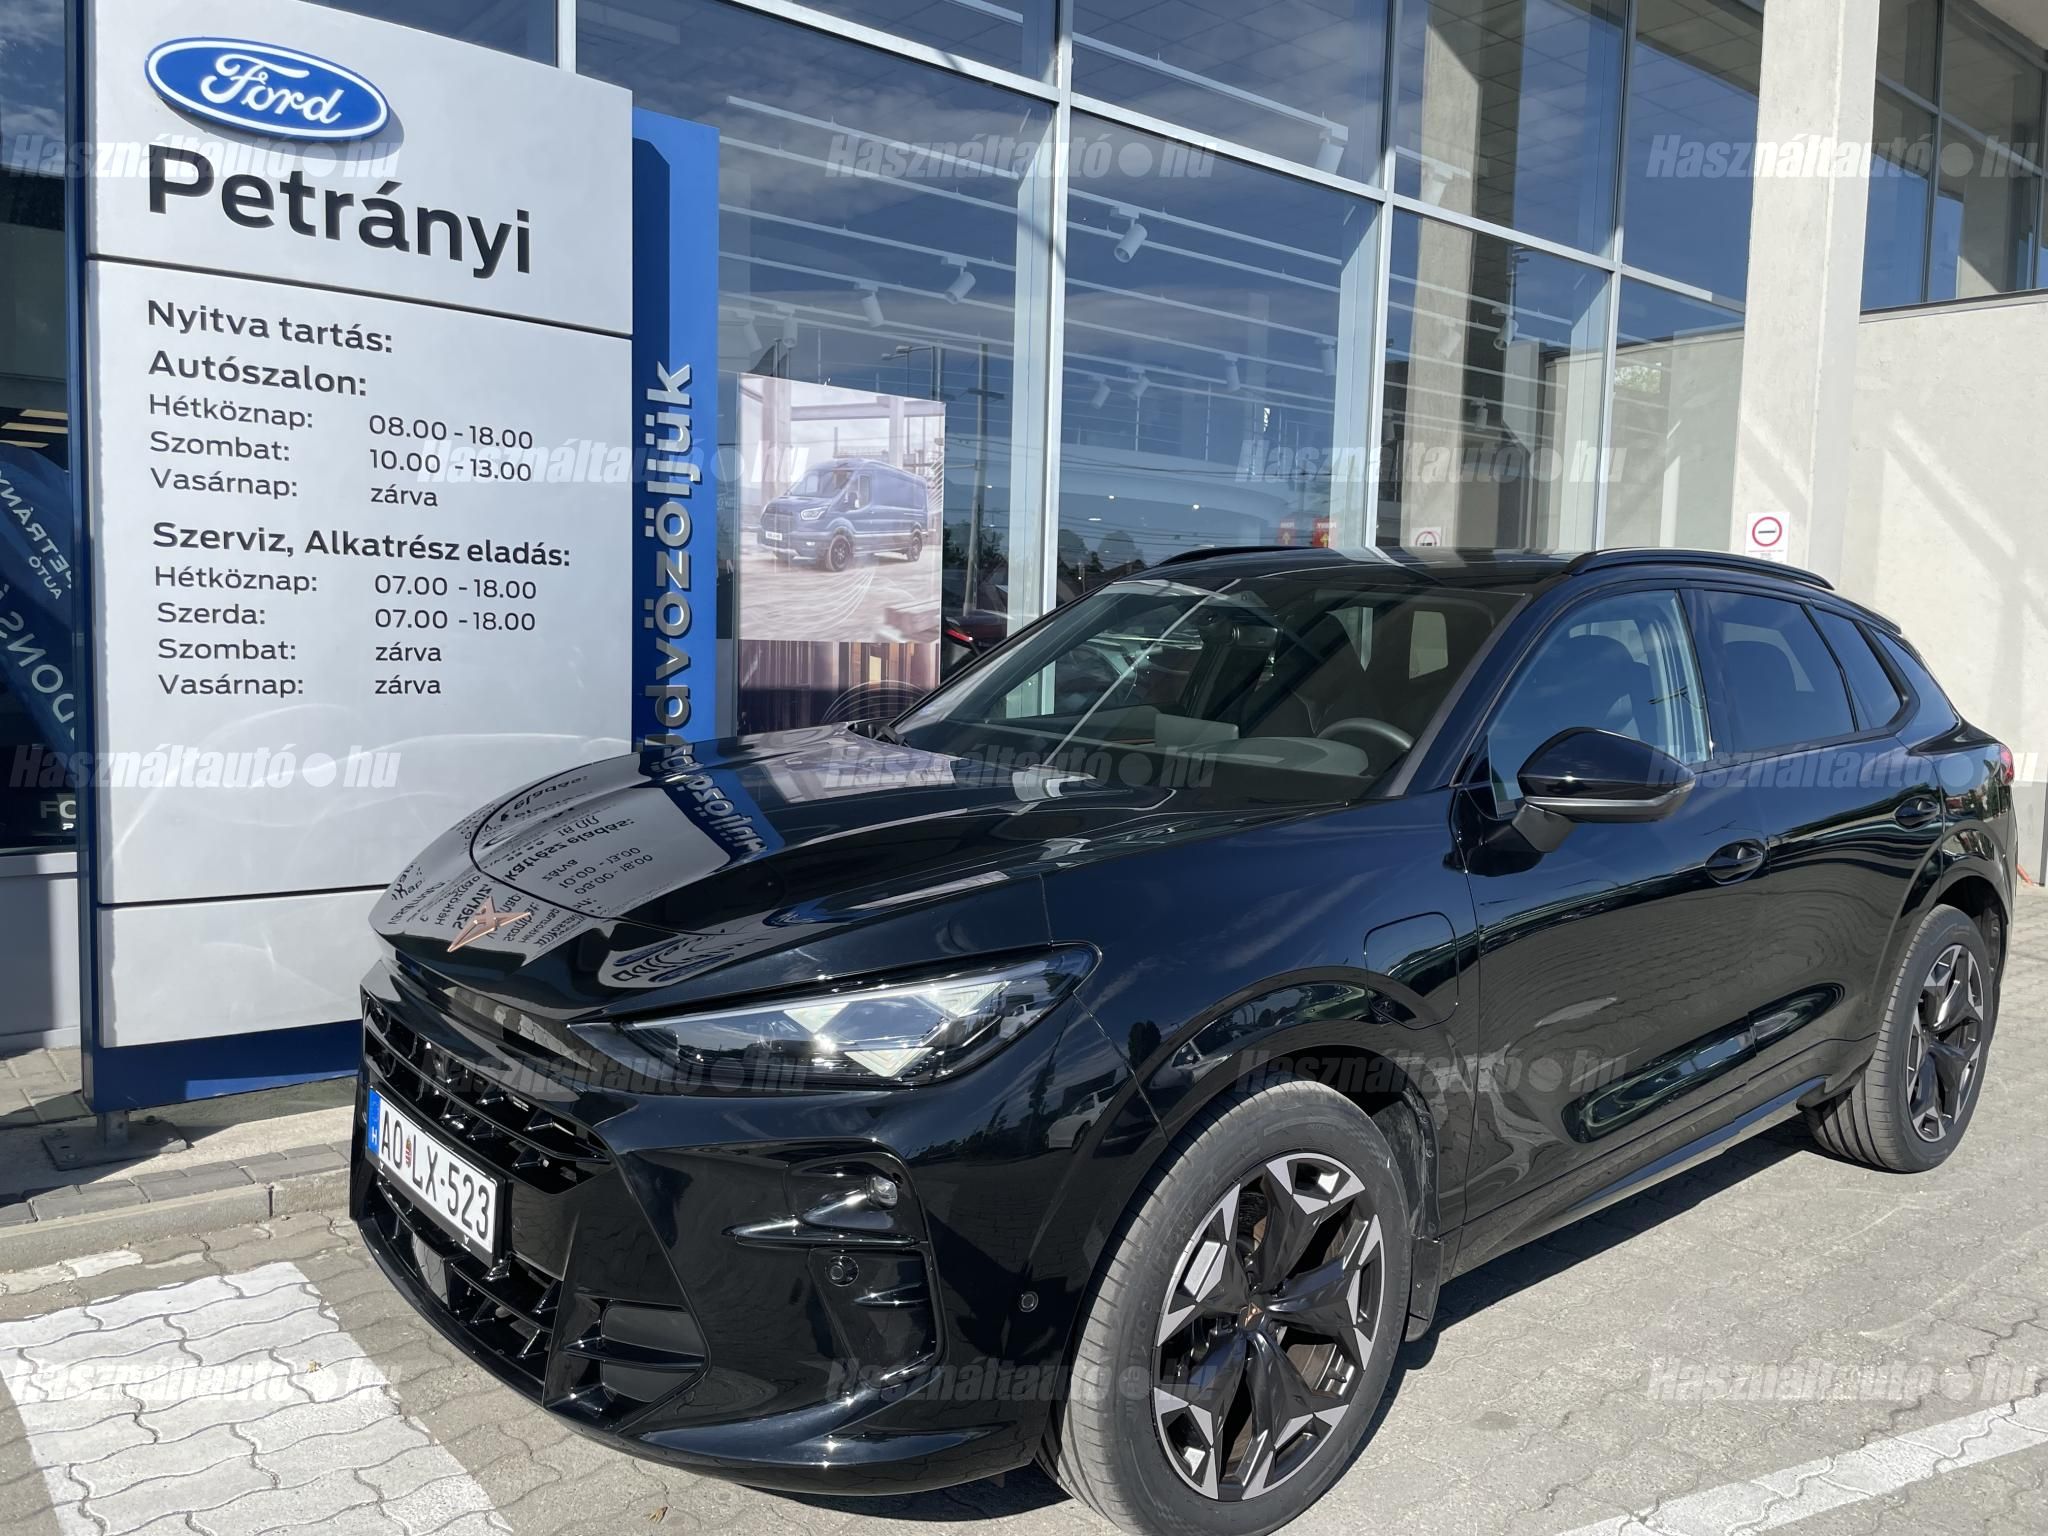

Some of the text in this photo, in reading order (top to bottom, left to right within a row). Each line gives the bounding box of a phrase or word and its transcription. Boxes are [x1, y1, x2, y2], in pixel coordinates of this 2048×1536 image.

[200, 53, 345, 126] Ford
[147, 143, 531, 279] Petrányi
[148, 299, 392, 353] Nyitva tartás:
[148, 350, 368, 396] Autószalon:
[150, 393, 313, 431] Hétköznap:
[149, 431, 290, 462] Szombat:
[369, 448, 441, 474] 10.00
[150, 467, 438, 507] Vasárnap: zárva
[153, 522, 570, 567] Szerviz, Alkatrész eladás:
[644, 361, 692, 746] dvözöljük
[155, 566, 317, 595] Hétköznap:
[374, 574, 448, 596] 07.00
[157, 602, 265, 625] Szerda:
[375, 608, 448, 629] 07.00
[158, 638, 442, 662] Szombat: zárva
[158, 673, 442, 699] Vasárnap: zárva
